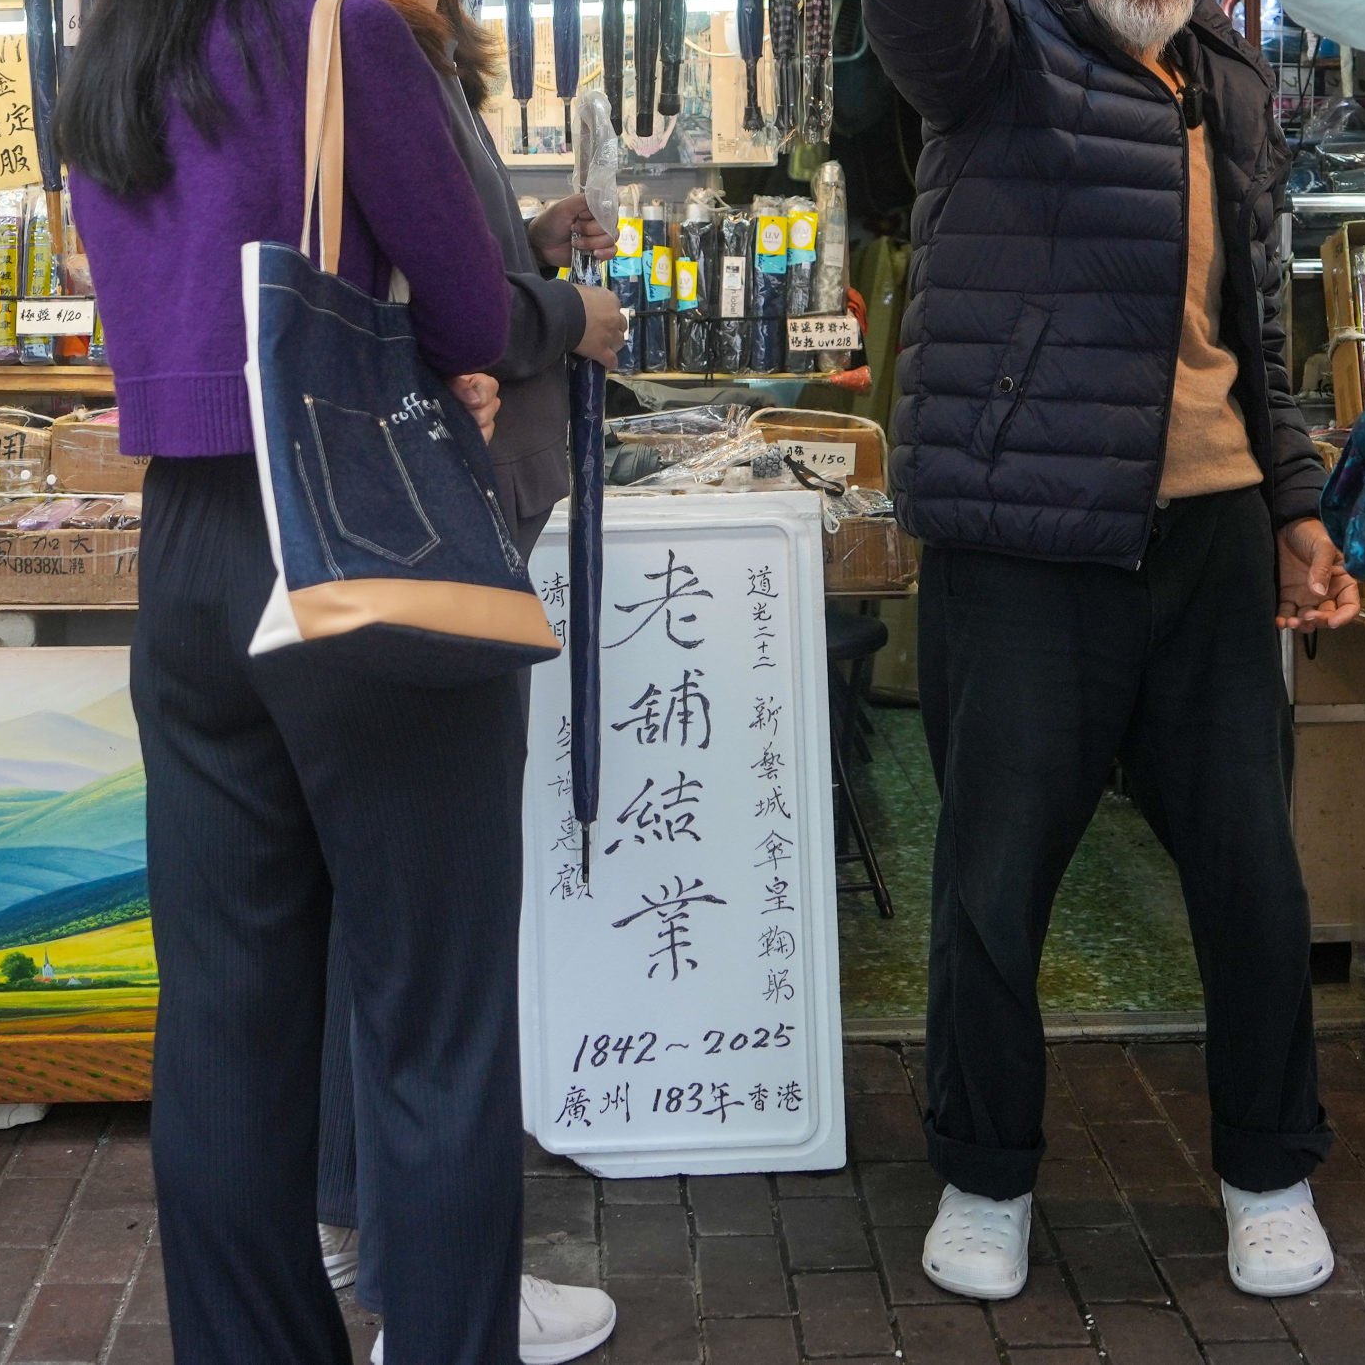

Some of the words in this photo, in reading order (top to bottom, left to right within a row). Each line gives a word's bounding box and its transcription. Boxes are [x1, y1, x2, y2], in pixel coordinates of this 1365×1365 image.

[746, 565, 779, 669] 道光二十二
[601, 549, 728, 981] 老舖結業
[555, 1081, 631, 1127] 廣州
